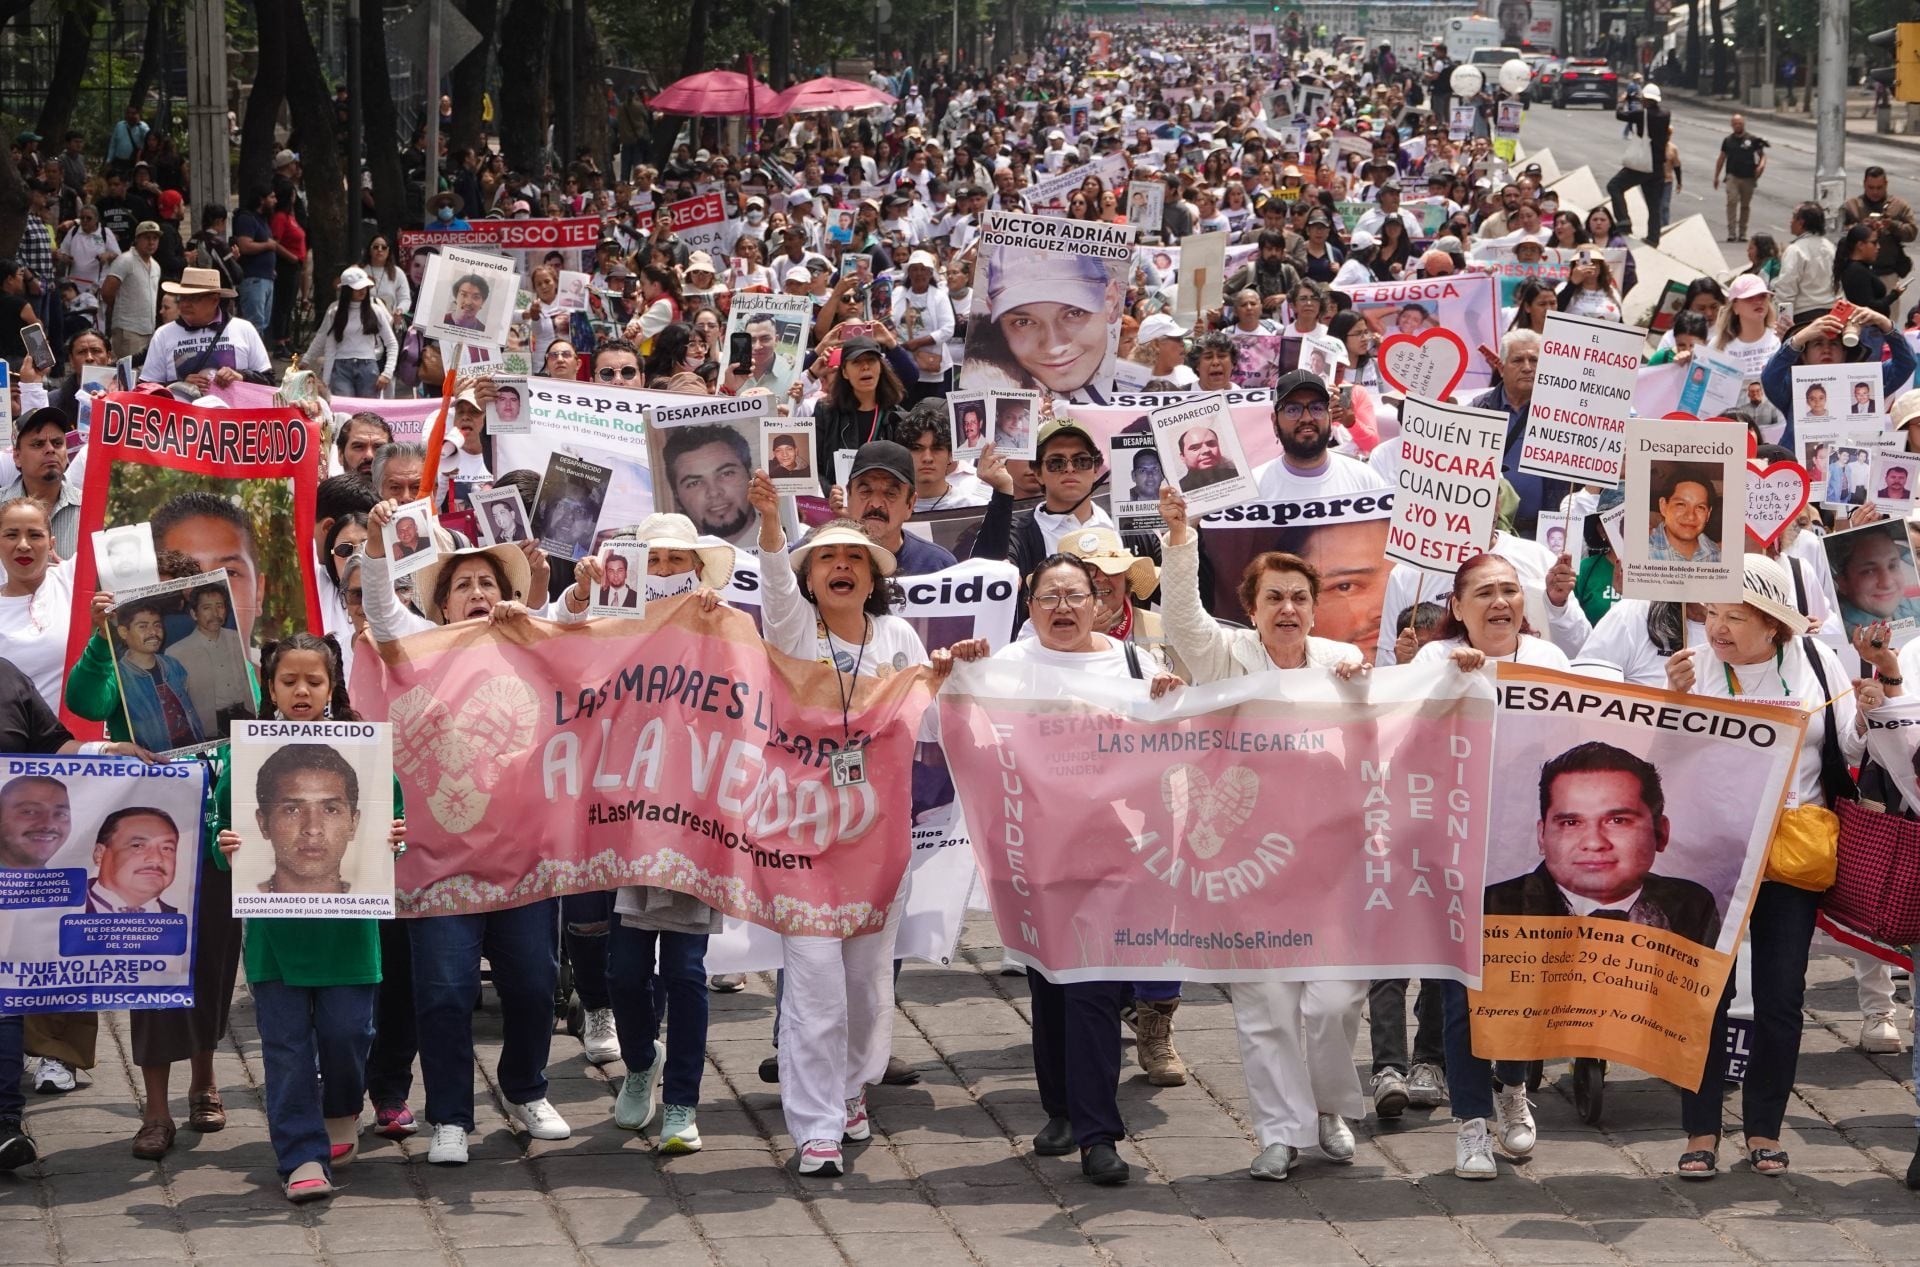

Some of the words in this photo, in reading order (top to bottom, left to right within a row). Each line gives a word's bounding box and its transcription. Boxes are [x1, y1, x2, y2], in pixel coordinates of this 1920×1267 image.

[402, 231, 499, 246] DESAPARECIDO
[501, 226, 559, 243] ISCO
[991, 216, 1057, 238] VICTOR
[1060, 223, 1127, 245] ADRIÁN
[984, 233, 1064, 252] RODRÍGUEZ
[1067, 242, 1129, 260] MORENO
[449, 254, 508, 272] Desaparecido
[1374, 283, 1459, 303] BUSCA
[1592, 334, 1600, 344] EL
[1543, 341, 1581, 361] GRAN
[1584, 347, 1638, 370] FRACASO
[1418, 360, 1435, 397] celebrar
[1583, 367, 1596, 377] DEL
[990, 389, 1037, 399] Desaparecido
[1537, 373, 1577, 391] ESTADO
[1579, 381, 1631, 401] MEXICANO
[656, 399, 762, 423] DESAPARECIDO
[1579, 398, 1589, 408] ES
[555, 408, 610, 428] Adrián
[612, 421, 645, 434] Rod
[1157, 403, 1221, 428] DESAPARECIDO
[1531, 404, 1551, 420] NO
[1553, 410, 1625, 434] ENCONTRAR
[102, 402, 308, 465] DESAPARECIDO
[593, 430, 616, 442] mayo
[629, 436, 646, 445] 200
[1404, 415, 1471, 446] ¿QUIÉN
[1478, 431, 1503, 451] TE
[1528, 425, 1537, 437] A
[1539, 427, 1598, 449] NUESTROS
[1607, 440, 1622, 453] AS
[1639, 438, 1734, 456] Desaparecido
[559, 456, 602, 474] DESAPARECIDO
[1401, 441, 1496, 480] BUSCARÁ
[1523, 445, 1618, 475] DESAPARECIDOS
[475, 488, 516, 501] Desaparecido
[1399, 470, 1491, 508] CUANDO
[1120, 504, 1134, 513] IVÁN
[1136, 503, 1159, 512] BARUCH
[1202, 493, 1395, 525] esaparec
[1541, 513, 1582, 522] Desaparcido
[1603, 508, 1625, 524] Desapa
[1405, 503, 1437, 528] ¿YO
[1445, 512, 1472, 535] YA
[1390, 526, 1416, 551] NO
[1642, 564, 1668, 572] Antonio
[1669, 565, 1695, 573] Robledo
[1696, 566, 1730, 574] Fernández
[555, 679, 610, 726] LAS
[614, 664, 749, 720] MADRES
[248, 724, 375, 737] DESAPARECIDO
[1097, 733, 1135, 754] LAS
[1141, 730, 1222, 754] MADRES
[1226, 728, 1324, 754] LLEGARÁN
[542, 731, 581, 801] A
[592, 717, 665, 791] LA
[9, 761, 190, 778] DESAPARECIDOS
[916, 841, 934, 850] de
[1443, 735, 1473, 943] DIGNIDAD
[23, 871, 64, 879] EDUARDO
[1143, 852, 1180, 889] LA
[1191, 831, 1296, 902] VERDAD
[37, 879, 70, 887] RANGEL
[6, 896, 30, 904] JULIO
[48, 895, 69, 903] 2018
[238, 896, 267, 904] EDSON
[269, 896, 306, 904] AMADEO
[308, 896, 319, 904] DE
[321, 896, 332, 904] LA
[334, 897, 357, 905] ROSA
[358, 897, 390, 906] GARCIA
[64, 918, 112, 926] FRANCISCO
[113, 918, 146, 926] RANGEL
[148, 918, 183, 926] VARGAS
[84, 926, 98, 934] FUE
[100, 926, 163, 934] DESAPARECIDO
[97, 934, 109, 942] 27
[122, 934, 159, 942] FEBRERO
[1114, 927, 1313, 951] #LasMadresNoSeRinden
[1483, 924, 1509, 940] sús
[1515, 926, 1573, 941] Antonio
[1576, 926, 1624, 944] Mena
[1631, 933, 1699, 969] Contreras
[20, 960, 85, 975] NUEVO
[89, 959, 168, 973] LAREDO
[1482, 951, 1537, 968] parecio
[1541, 951, 1574, 963] desde:
[1577, 951, 1598, 963] 29
[1602, 953, 1621, 967] de
[1625, 957, 1664, 981] Junio
[1665, 970, 1679, 985] de
[1680, 974, 1710, 999] 2010
[15, 971, 140, 987] TAMAULIPAS
[1510, 970, 1536, 983] En:
[1540, 970, 1588, 985] Torreón,
[1592, 970, 1660, 997] Coahuila
[4, 993, 87, 1008] SEGUIMOS
[91, 992, 183, 1005] BUSCANDO
[1475, 1006, 1520, 1018] Esperes
[1551, 1004, 1598, 1016] Olvidemos
[1599, 1009, 1607, 1018] y
[1609, 1008, 1627, 1020] No
[1630, 1013, 1664, 1033] Olvides
[1664, 1028, 1678, 1040] que
[1677, 1032, 1688, 1044] te
[1547, 1018, 1594, 1030] Esperamos
